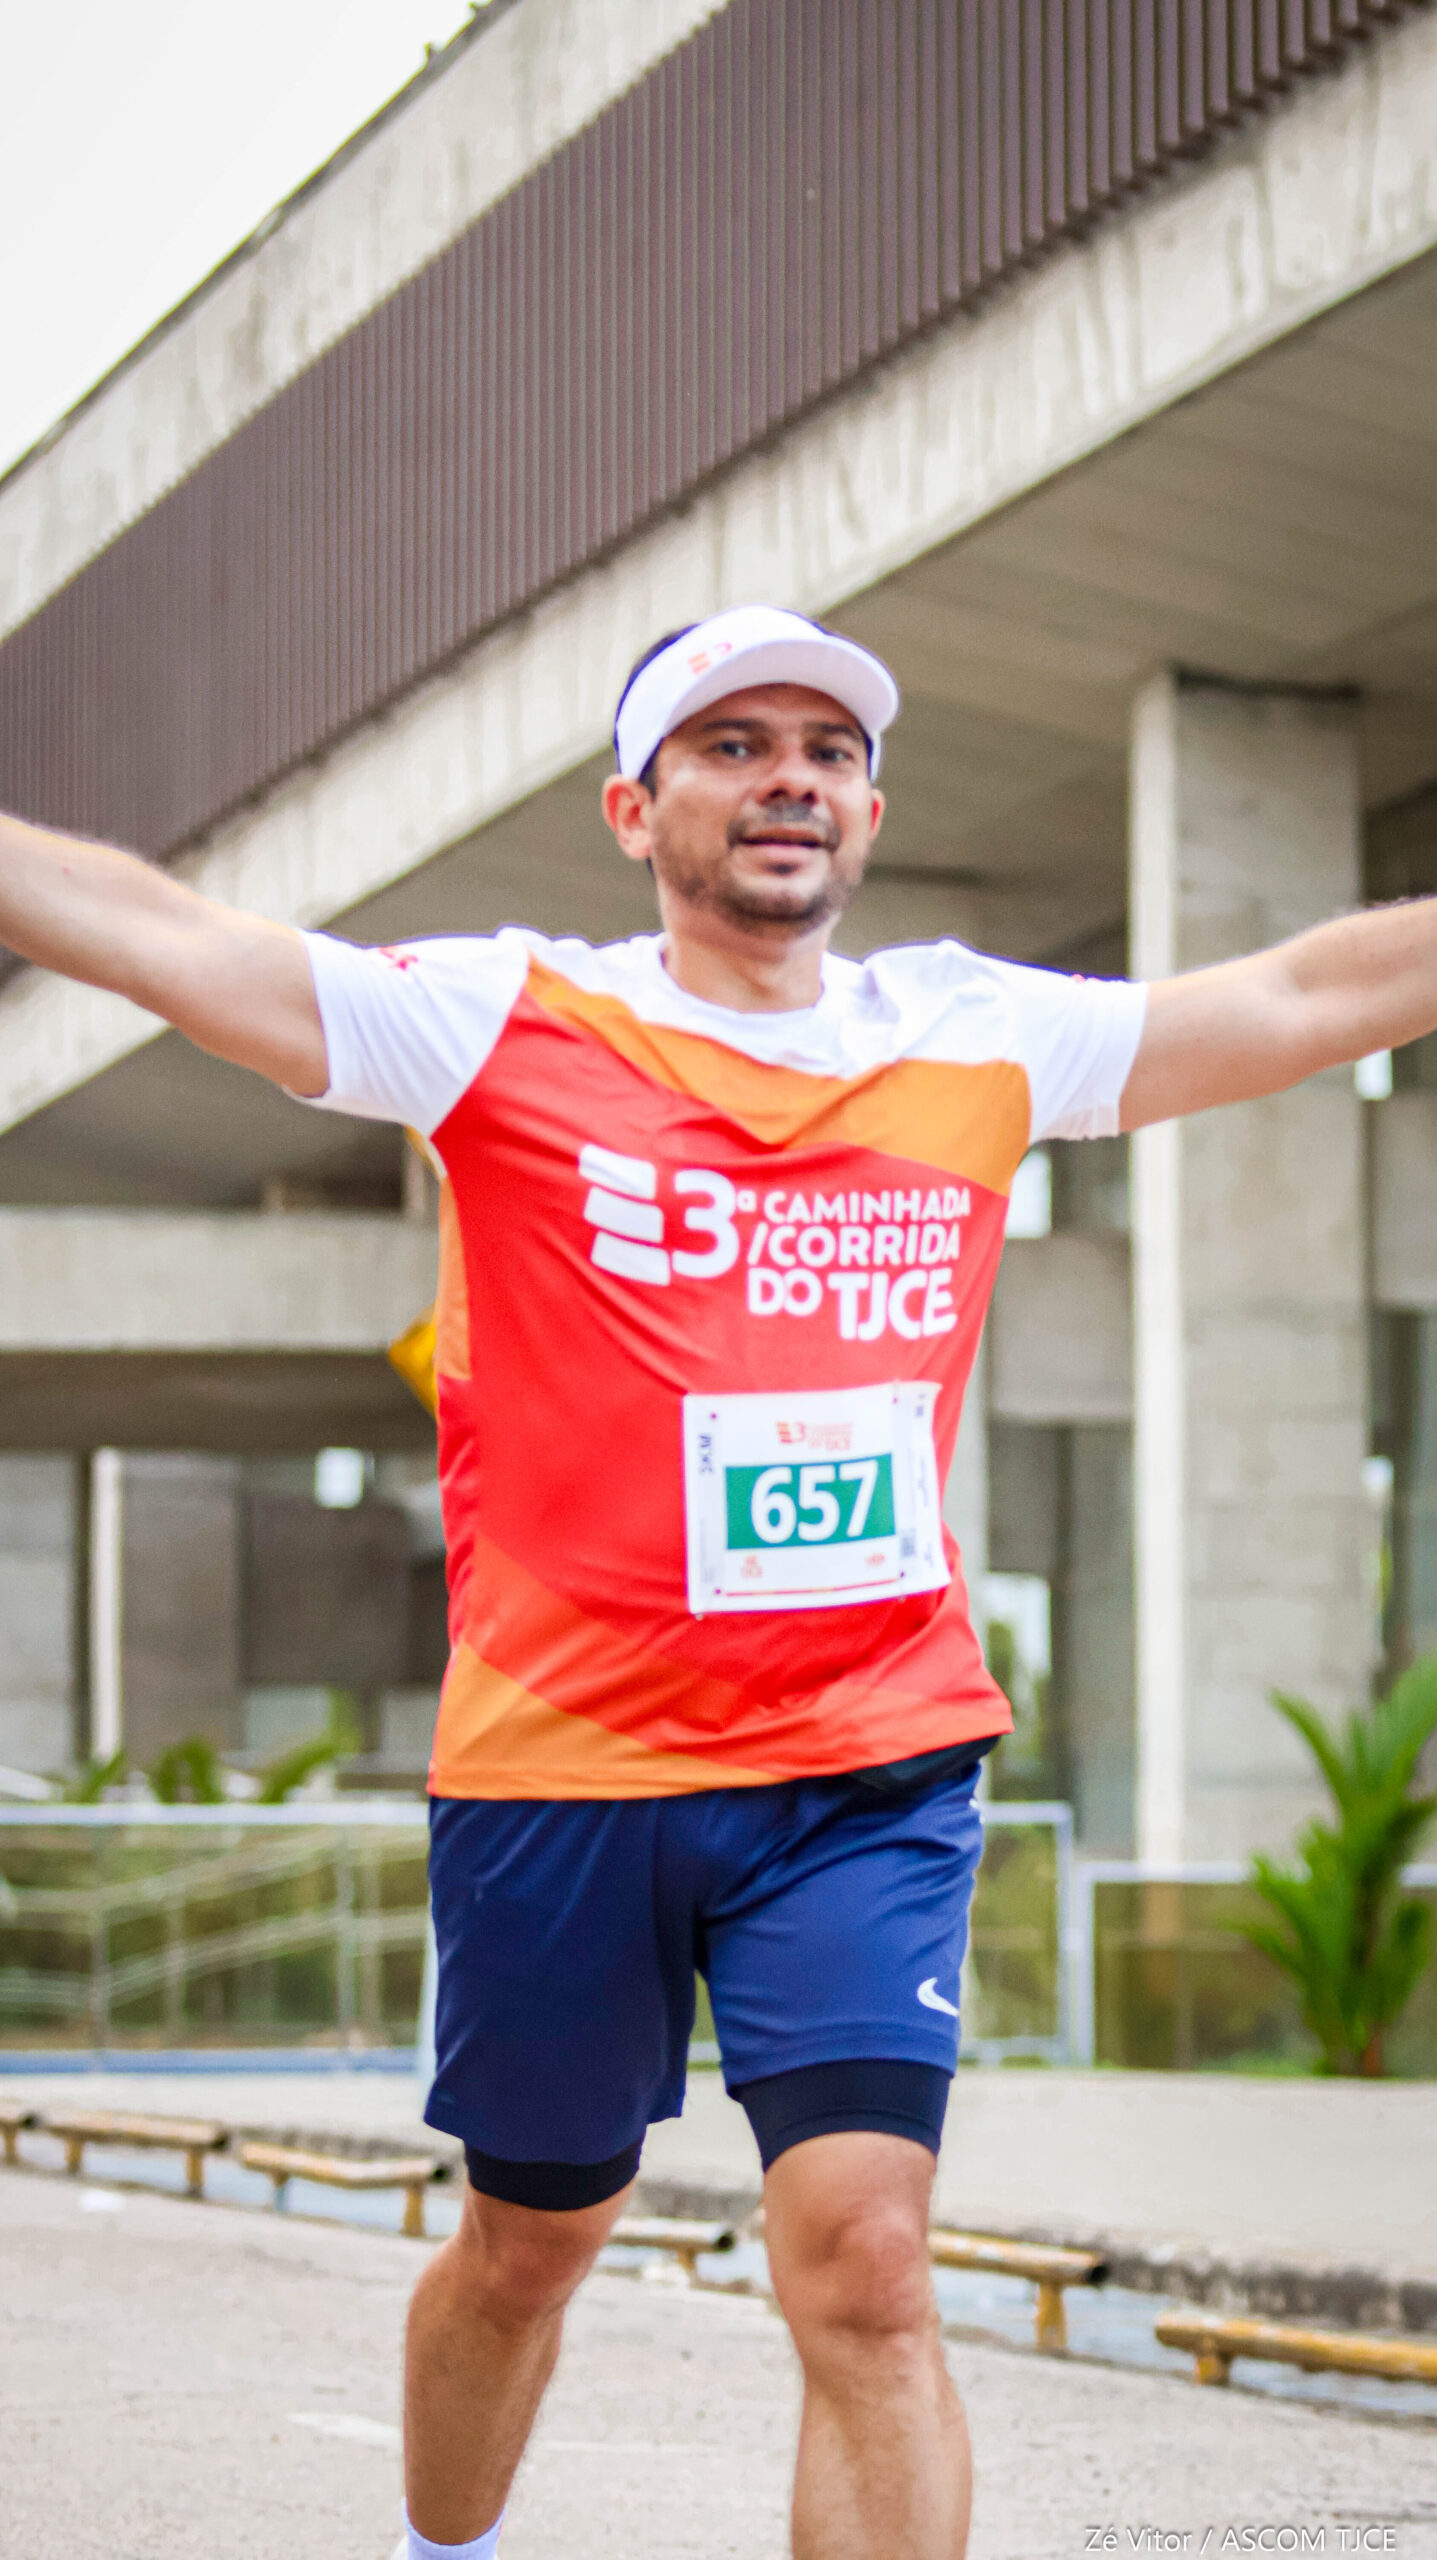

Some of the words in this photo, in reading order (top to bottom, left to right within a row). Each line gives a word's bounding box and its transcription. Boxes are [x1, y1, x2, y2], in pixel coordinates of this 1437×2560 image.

[763, 1187, 971, 1222] CAMINHADA
[748, 1222, 960, 1267] /CORRIDA
[747, 1267, 824, 1317] DO
[827, 1267, 959, 1342] TJCE
[751, 1459, 879, 1545] 657
